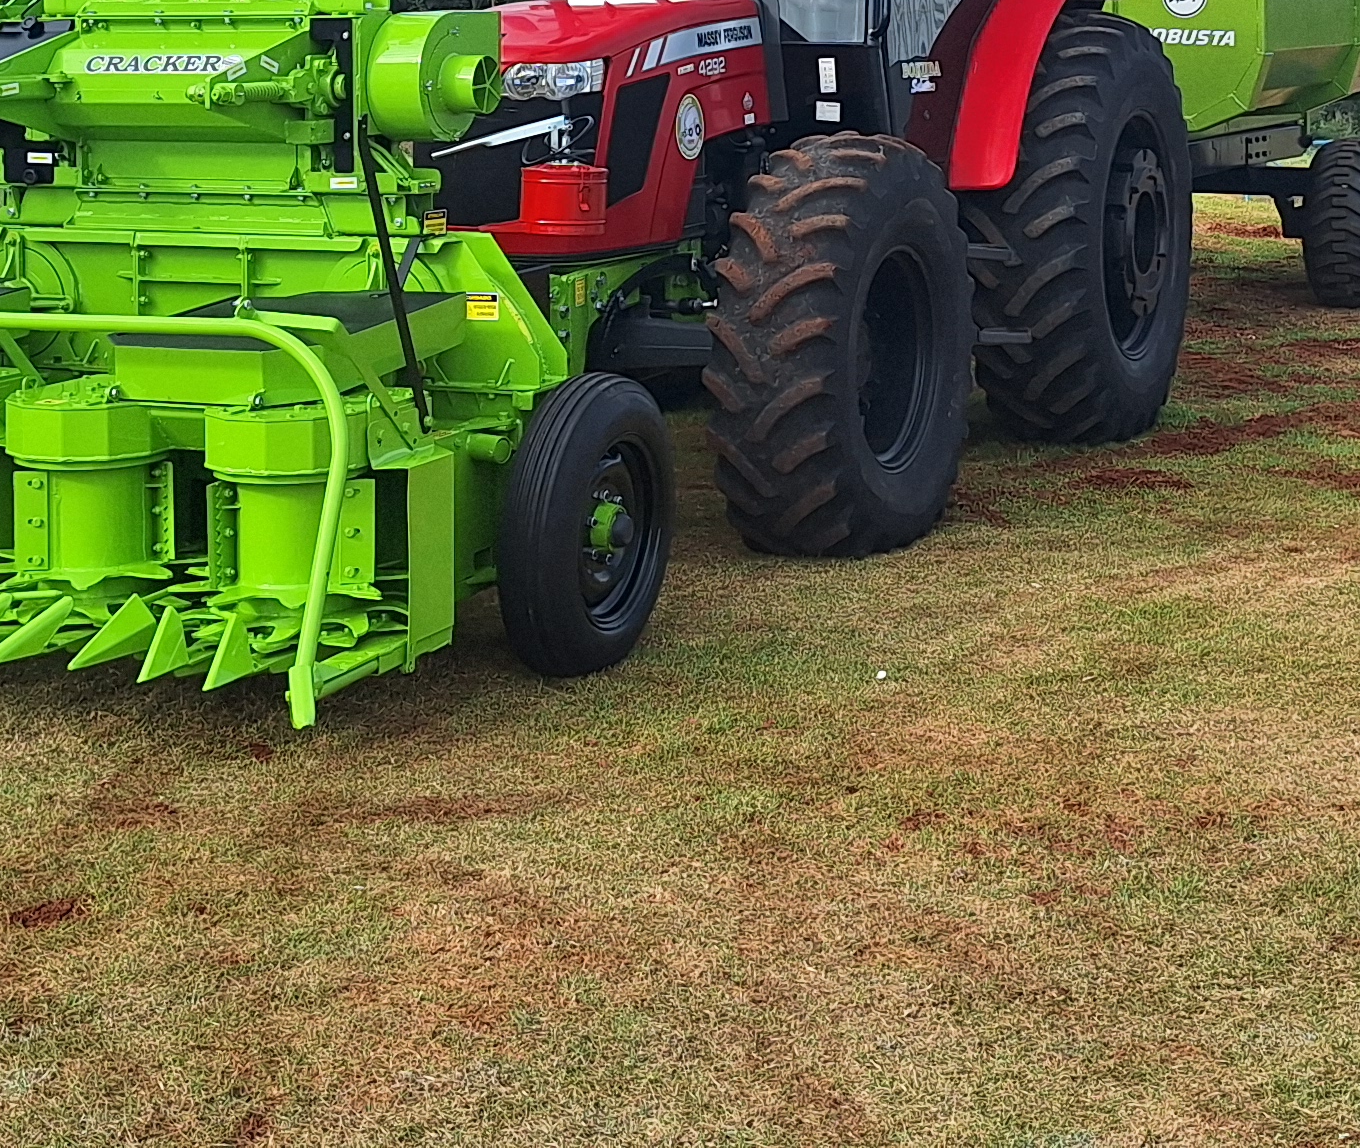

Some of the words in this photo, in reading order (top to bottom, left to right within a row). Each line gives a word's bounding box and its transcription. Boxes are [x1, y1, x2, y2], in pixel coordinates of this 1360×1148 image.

[1149, 28, 1236, 47] OBUSTA
[86, 54, 223, 73] CRACKER
[698, 56, 726, 77] 4292
